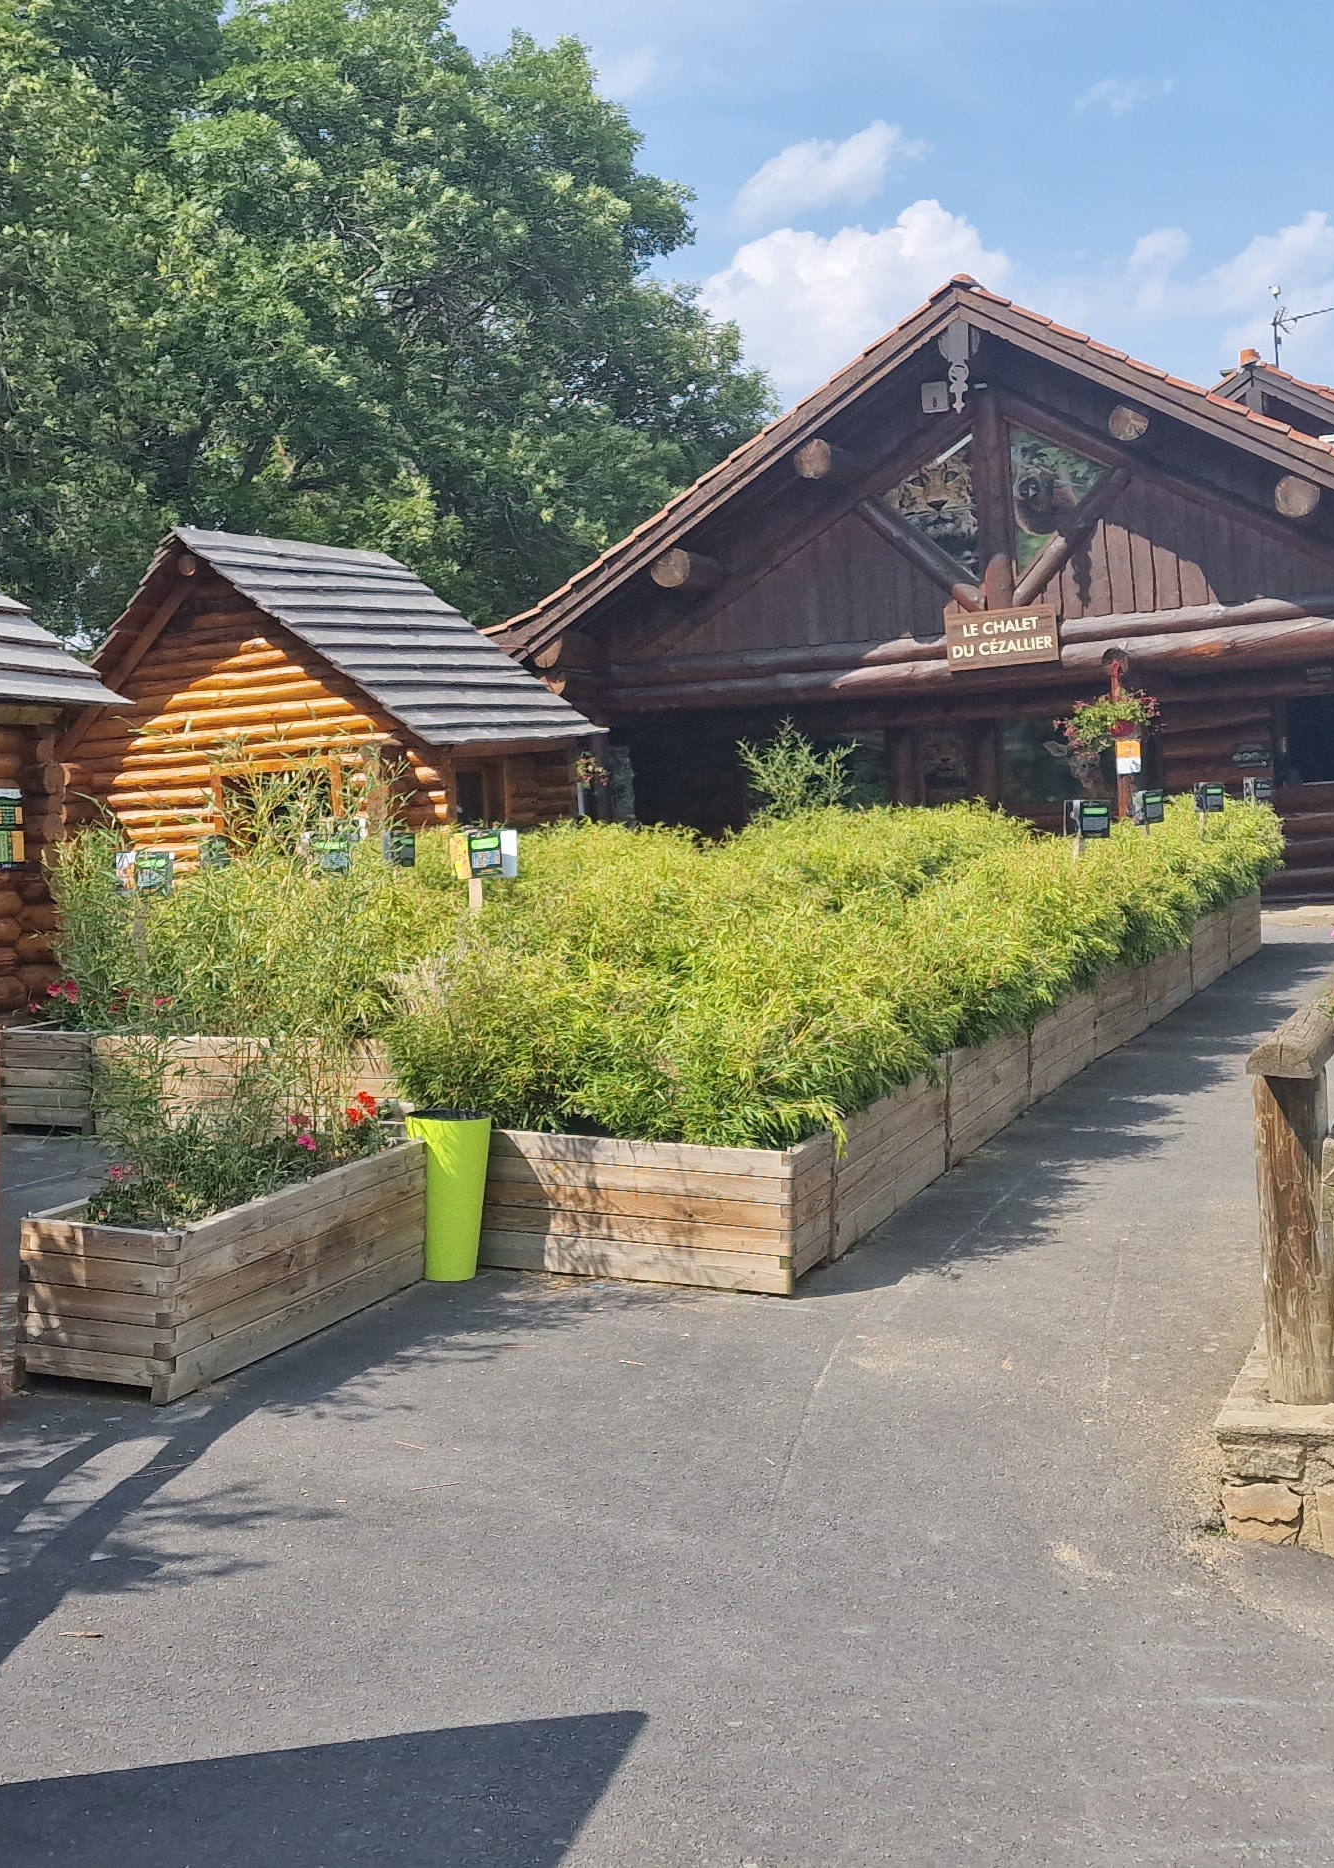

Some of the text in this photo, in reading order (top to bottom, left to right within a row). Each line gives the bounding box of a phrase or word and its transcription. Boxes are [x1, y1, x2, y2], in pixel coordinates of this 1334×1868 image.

[962, 616, 1039, 638] LE CHALET
[952, 636, 1054, 659] DU CÉZALLIER
